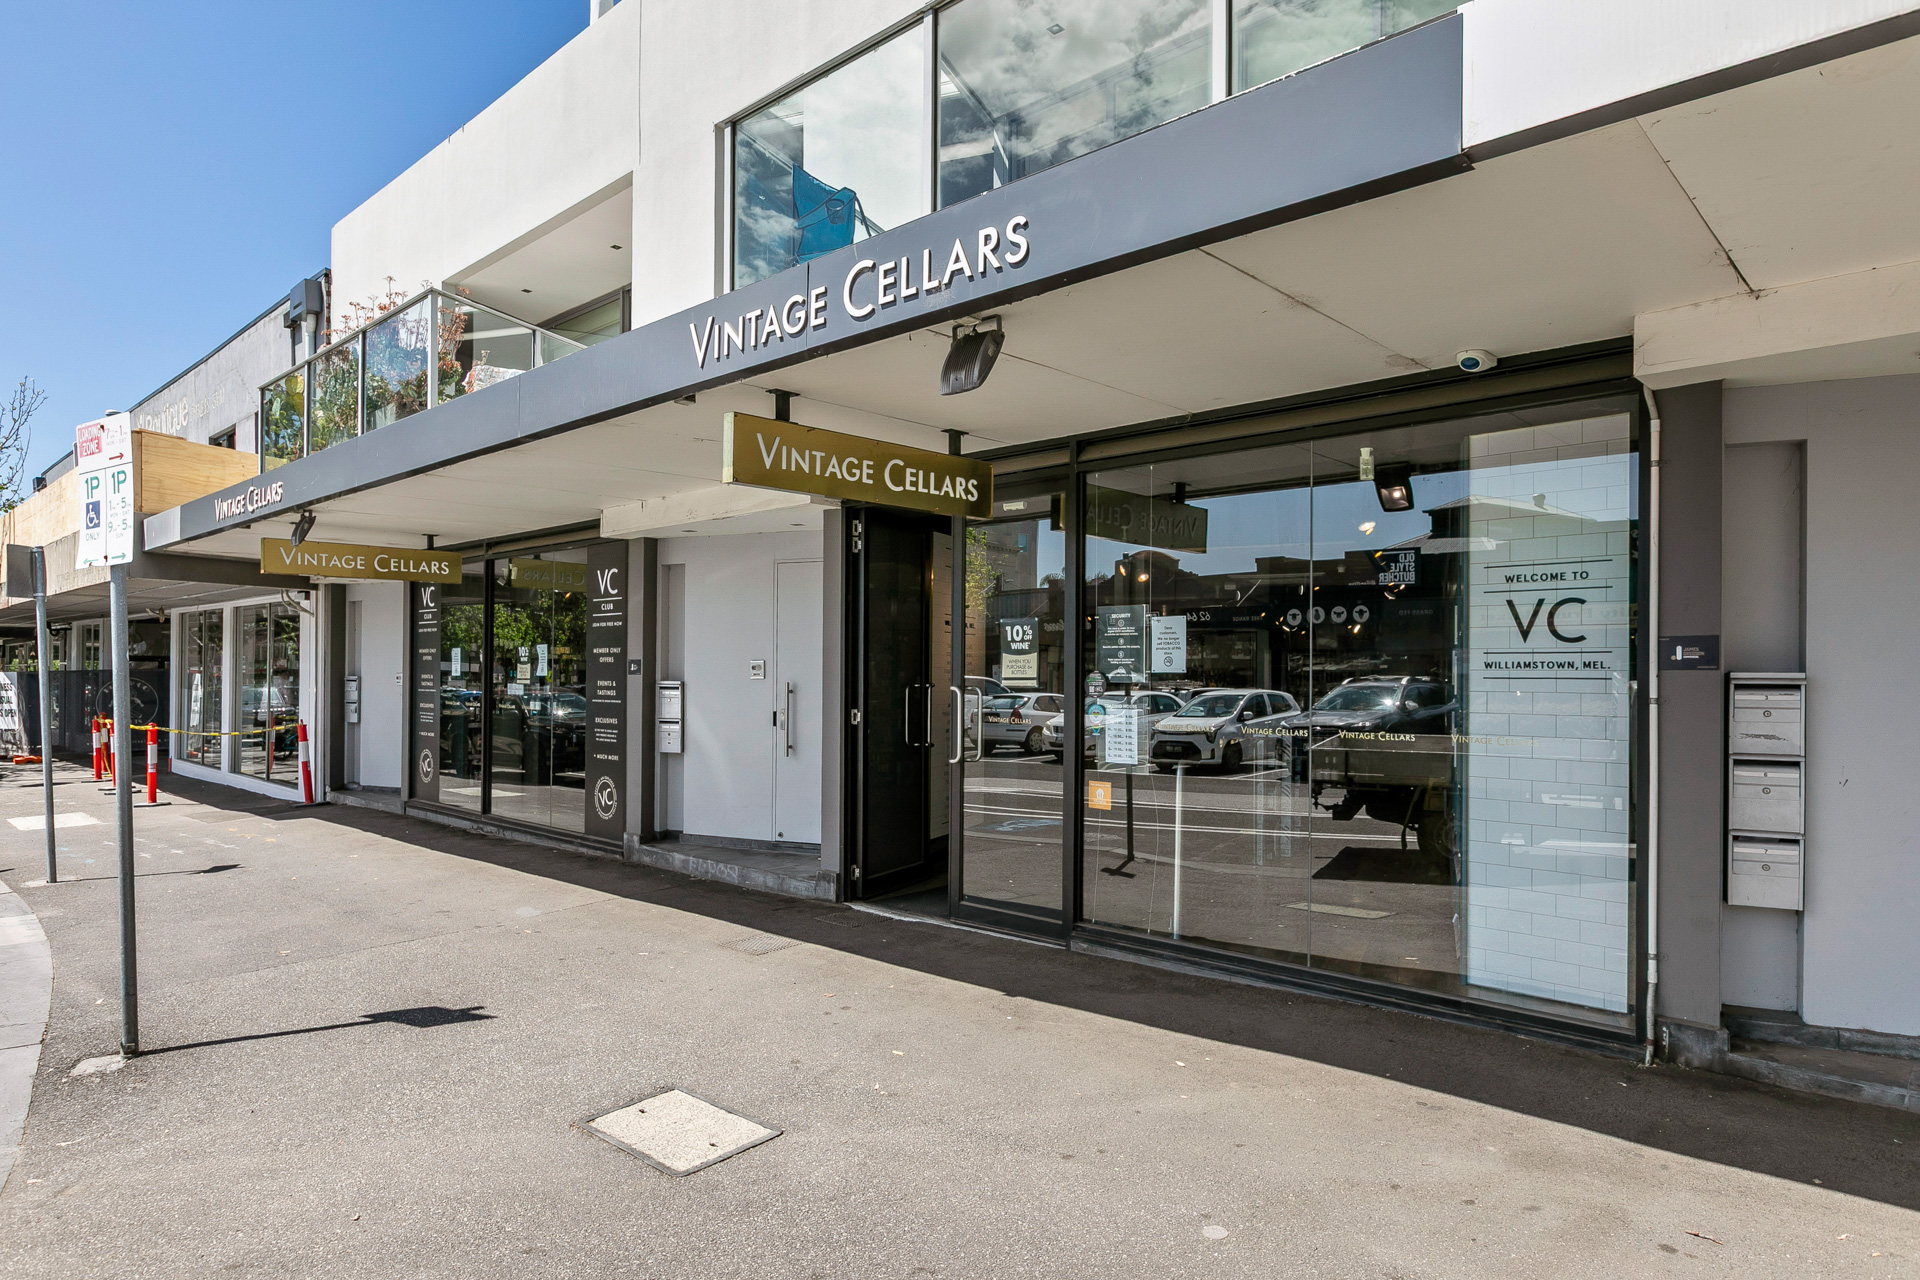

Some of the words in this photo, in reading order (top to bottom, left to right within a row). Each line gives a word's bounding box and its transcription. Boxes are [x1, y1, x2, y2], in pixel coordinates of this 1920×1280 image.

[689, 286, 827, 369] VINTAGE
[843, 215, 1029, 318] CELLARS
[79, 424, 101, 442] LOADING
[82, 439, 100, 456] ZONE
[757, 432, 874, 484] VINTAGE
[884, 459, 978, 502] CELLARS
[85, 476, 100, 499] 1P
[112, 470, 127, 494] 1P
[214, 494, 246, 522] VINTAGE
[247, 481, 283, 512] CELLARS
[86, 532, 100, 541] ONLY
[280, 547, 366, 569] VINTAGE
[374, 554, 449, 575] CELLARS
[597, 568, 618, 595] VC
[1505, 572, 1566, 583] WELCOME
[1572, 571, 1589, 580] TO
[421, 586, 435, 607] VC
[1505, 597, 1587, 644] VC
[1484, 661, 1580, 670] WILLIAMSTOWN,
[1583, 661, 1611, 669] MEL.
[988, 715, 1009, 723] VINTAGE
[1010, 716, 1032, 725] CELLARS
[1241, 725, 1273, 735] VINTAGE
[1275, 727, 1309, 737] CELLARS
[1338, 729, 1375, 740] VINTAGE
[1378, 731, 1416, 742] CELLARS
[1451, 734, 1493, 745] VINTAGE
[598, 788, 613, 807] VC
